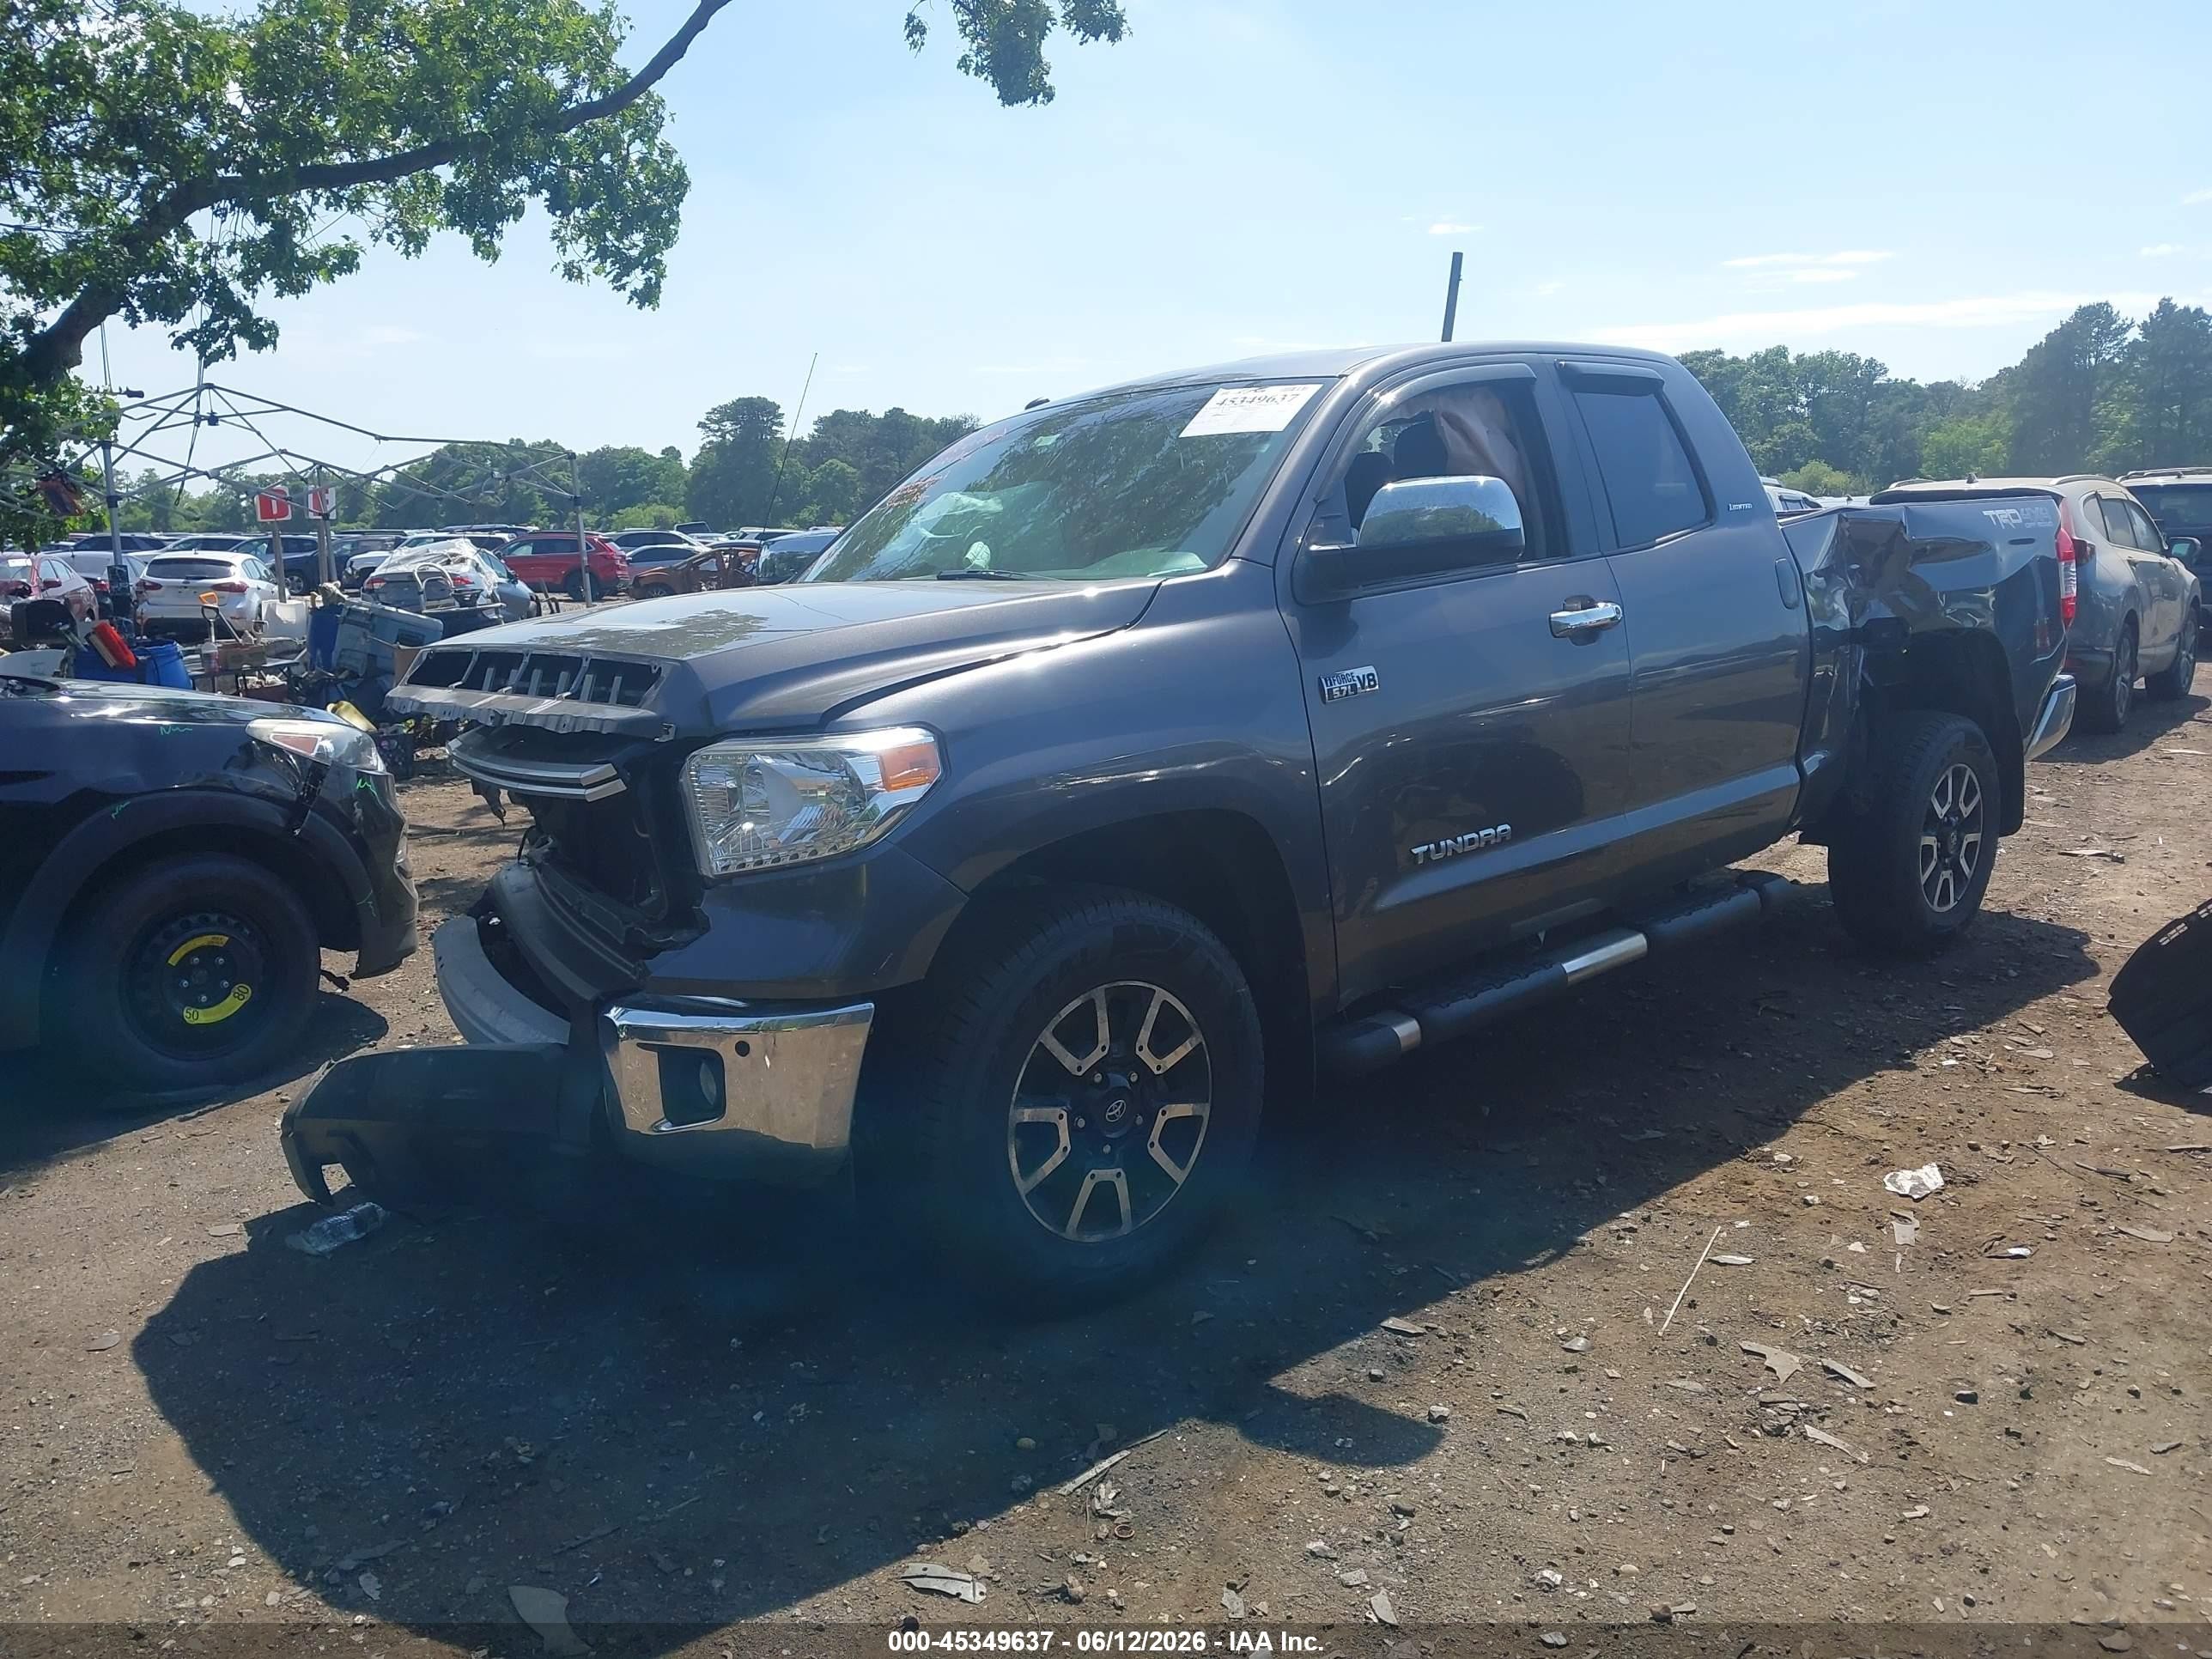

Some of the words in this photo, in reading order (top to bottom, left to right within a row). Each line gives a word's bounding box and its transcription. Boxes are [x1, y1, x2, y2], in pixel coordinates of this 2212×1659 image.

[1982, 507, 2023, 530] TRD
[1356, 672, 1377, 690] V8
[1410, 823, 1512, 866] TUNDRA
[185, 1008, 199, 1022] 50
